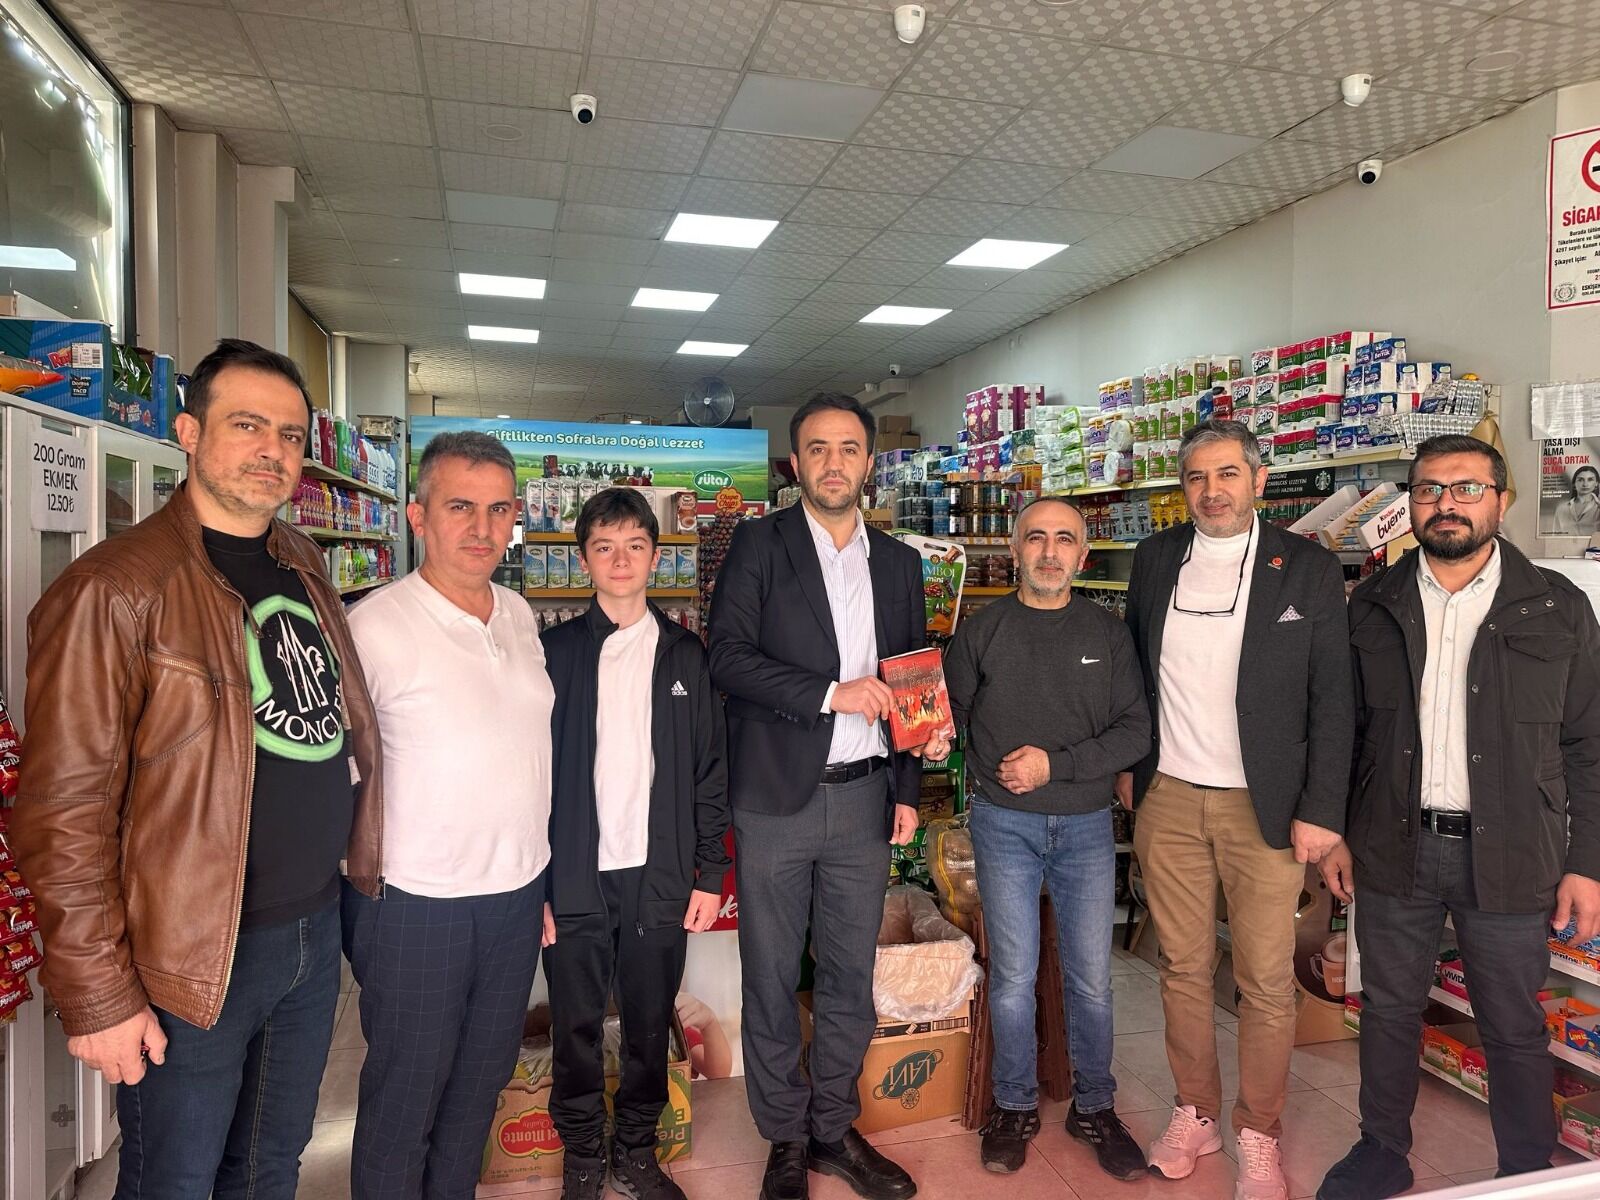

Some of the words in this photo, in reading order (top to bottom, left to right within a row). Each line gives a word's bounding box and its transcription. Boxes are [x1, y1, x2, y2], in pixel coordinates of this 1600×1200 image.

[1233, 385, 1250, 401] Solo
[556, 433, 617, 446] Sofralara
[620, 434, 659, 449] Doğal
[662, 437, 704, 449] Lezzet
[1543, 438, 1563, 447] YASA
[1564, 437, 1581, 447] DIŞI
[33, 442, 55, 464] 200
[56, 448, 86, 470] Gram
[1543, 447, 1564, 456] ALMA
[1542, 456, 1563, 466] SUÇA
[1564, 455, 1590, 465] ORTAK
[43, 468, 79, 491] EKMEK
[697, 473, 729, 488] sütaş
[1377, 506, 1406, 539] bueno
[887, 1058, 933, 1087] LAVI
[522, 1119, 550, 1129] Quality
[1567, 1119, 1586, 1130] sour
[503, 1129, 545, 1143] Monte
[547, 1128, 558, 1141] el
[656, 1127, 685, 1141] Pre
